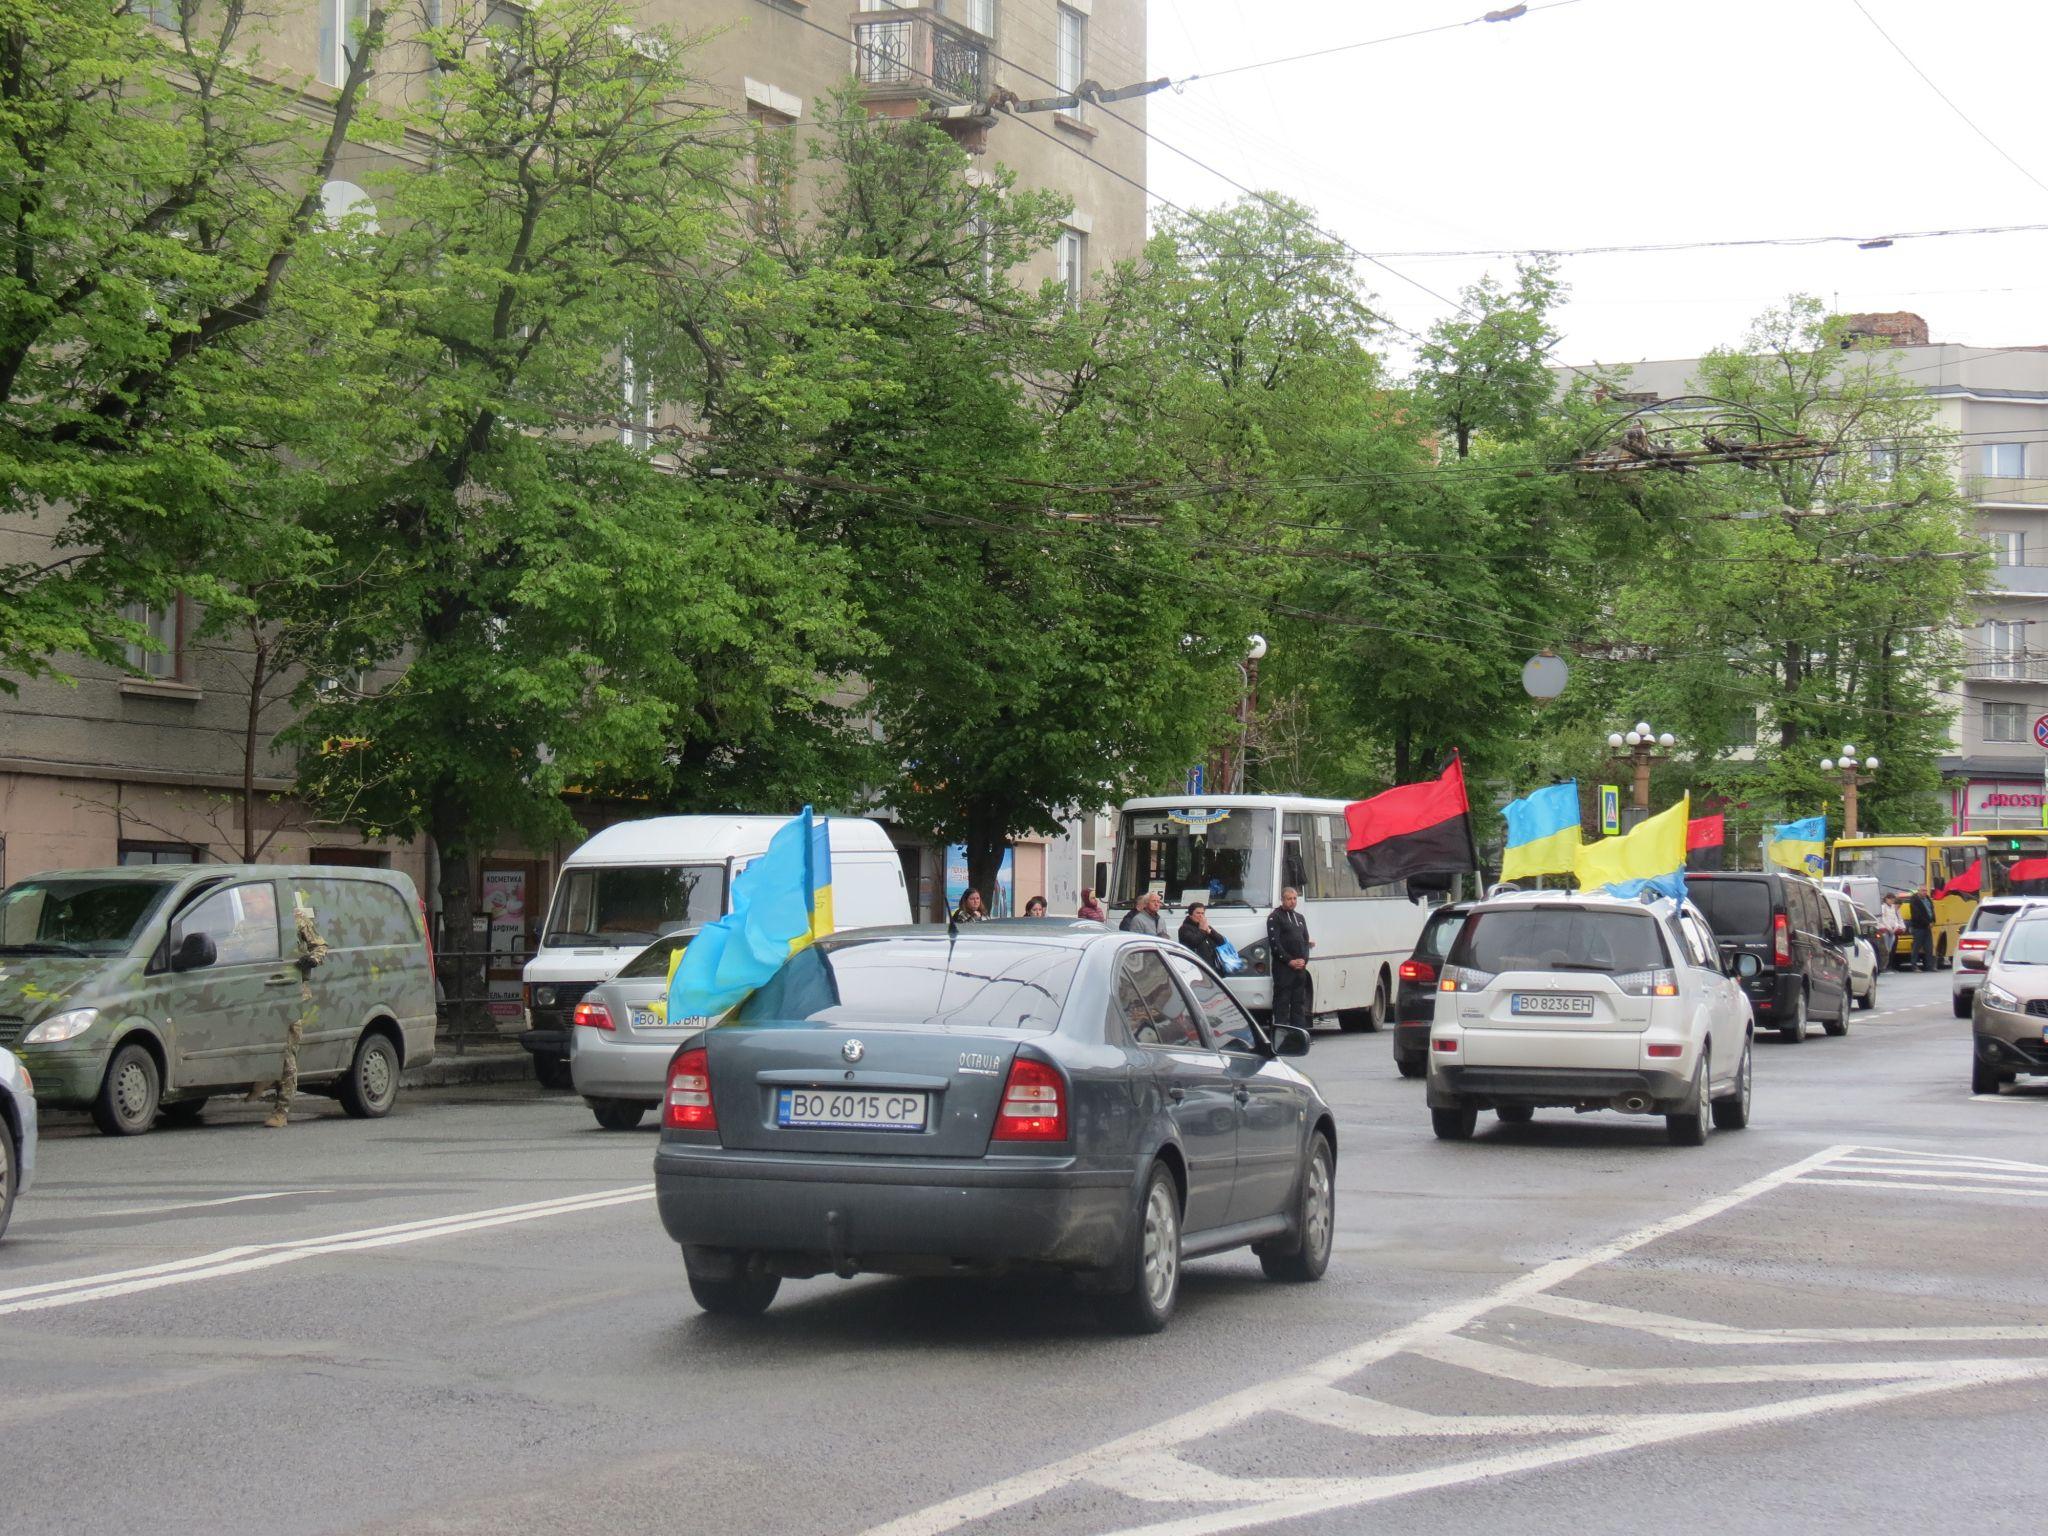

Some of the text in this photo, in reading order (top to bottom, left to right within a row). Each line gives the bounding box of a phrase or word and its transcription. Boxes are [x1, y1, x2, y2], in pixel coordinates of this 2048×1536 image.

[1153, 823, 1170, 835] 15
[487, 875, 522, 883] КОСМЕТИКА
[1520, 998, 1539, 1010] BO
[1541, 998, 1570, 1011] 8236
[1572, 999, 1591, 1011] EH
[639, 1014, 655, 1025] BO
[959, 1052, 1001, 1069] OCTAVIA
[794, 1094, 918, 1120] BO 6015 CP
